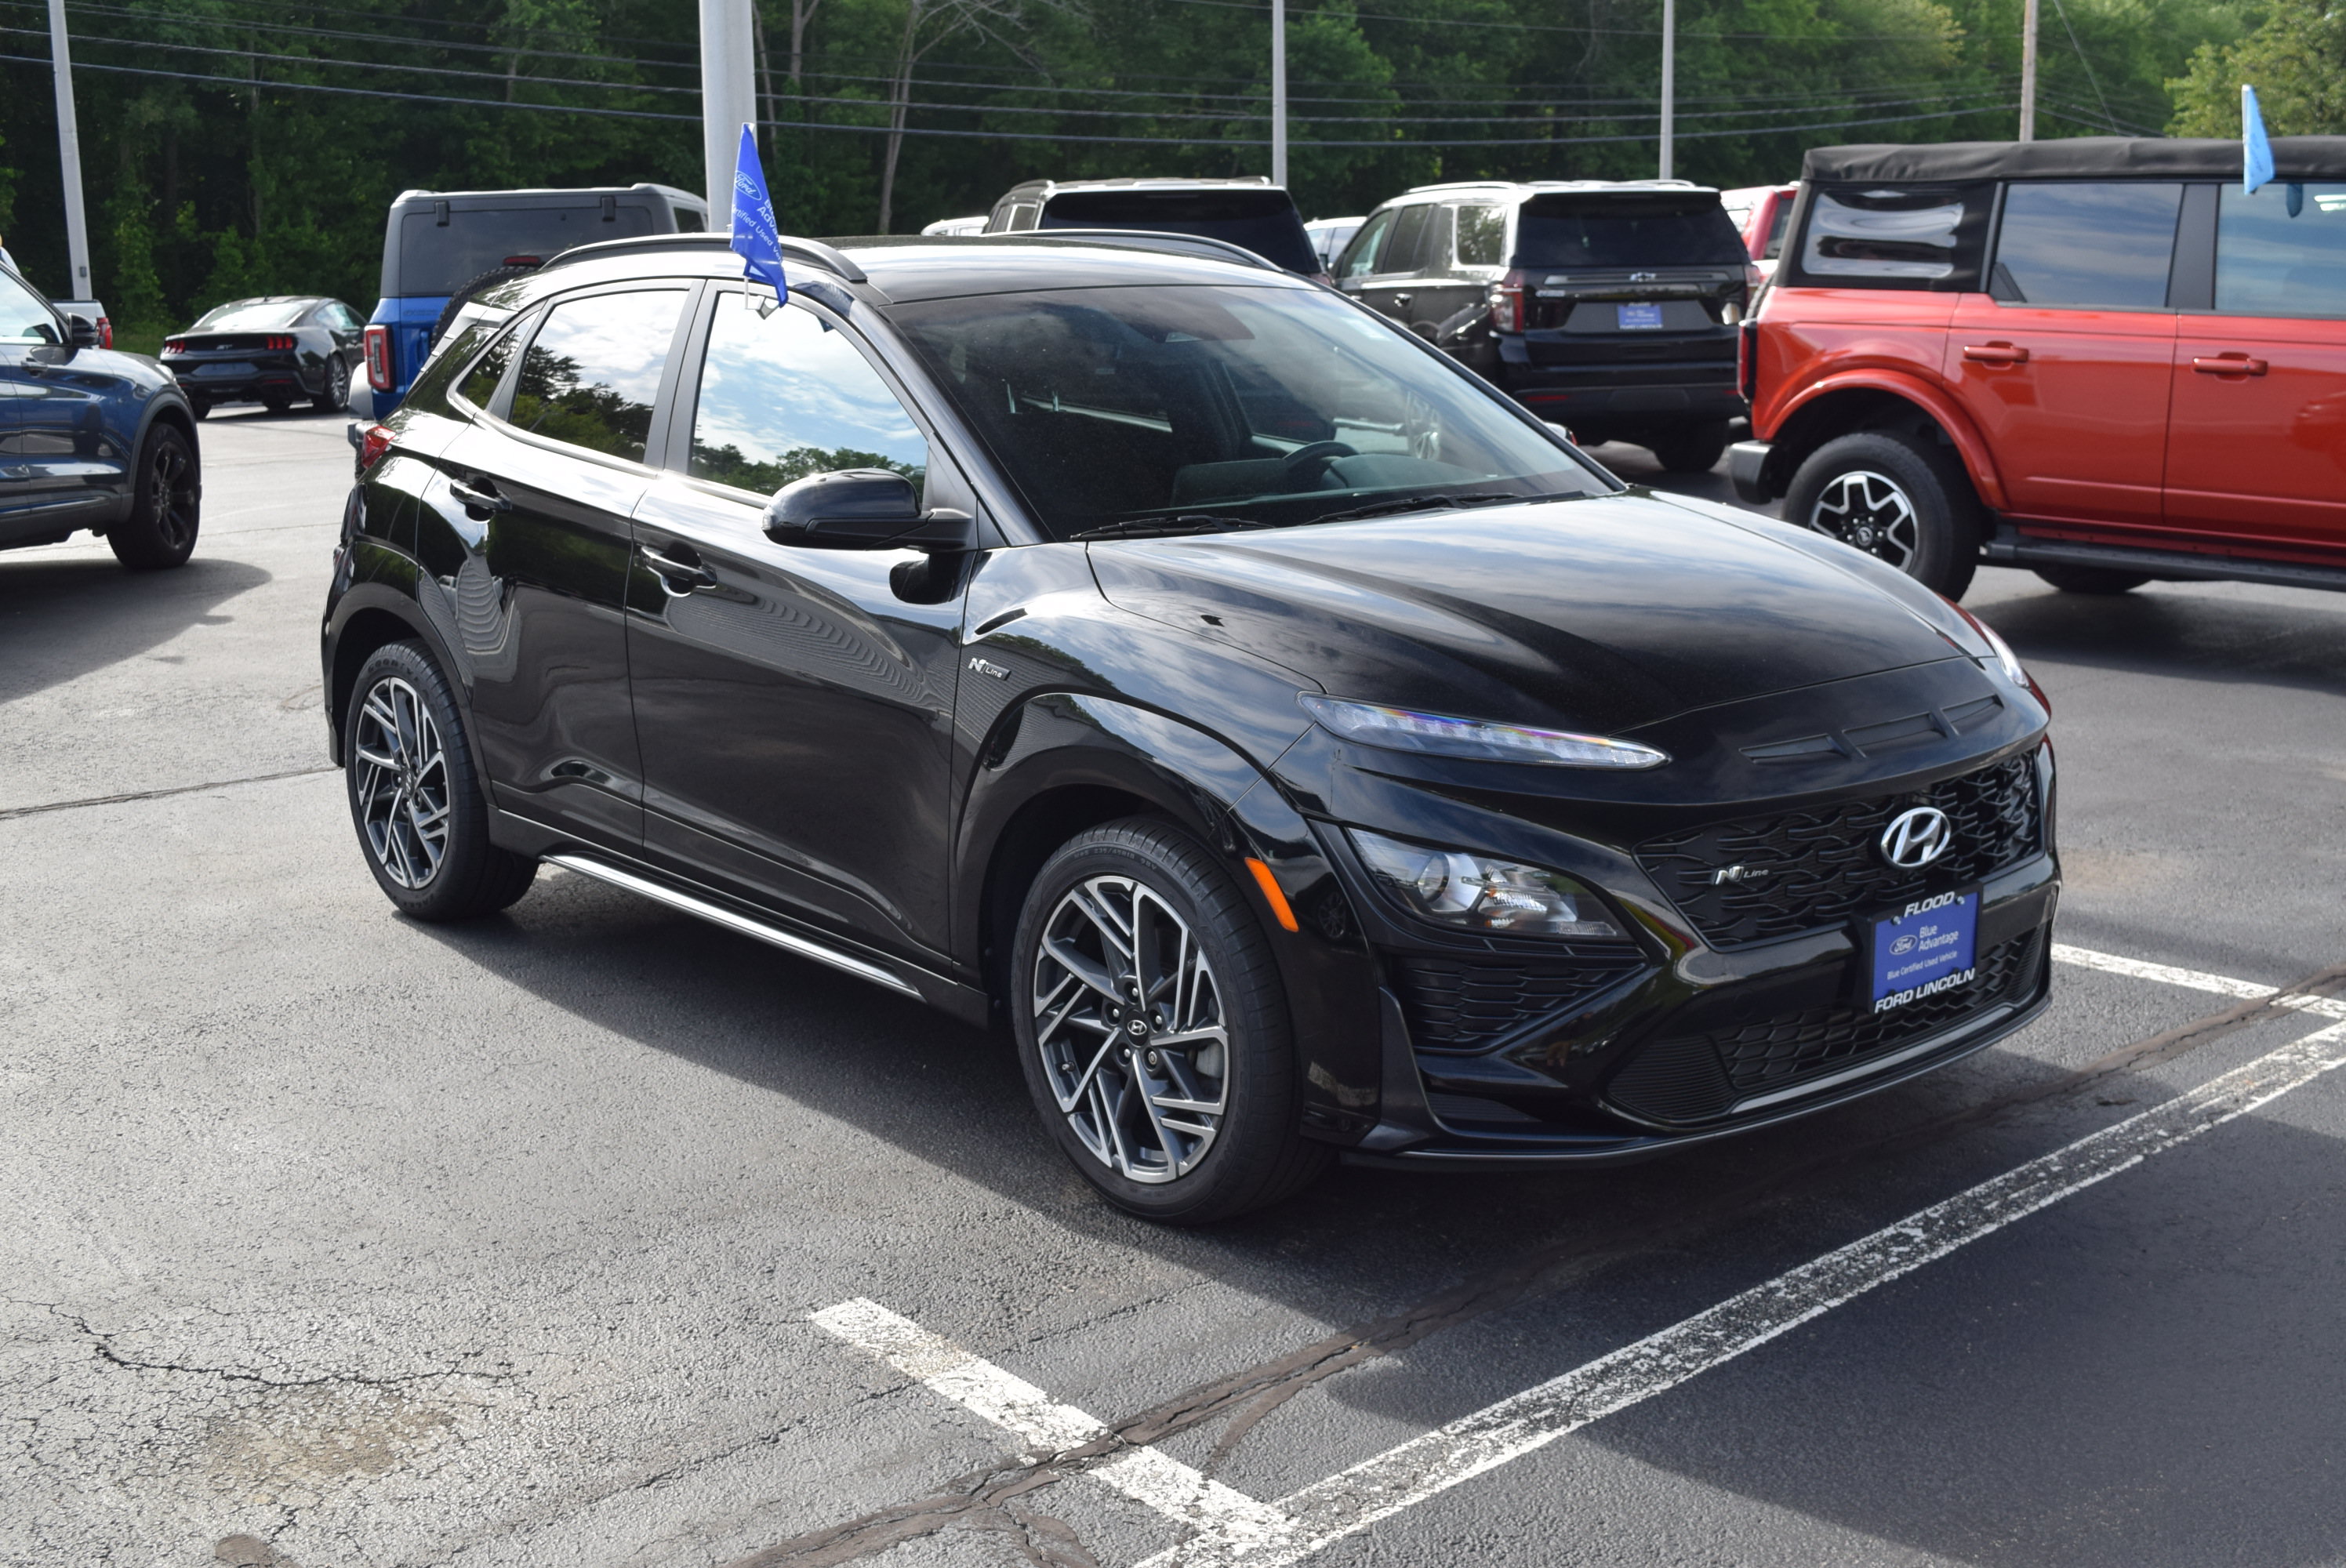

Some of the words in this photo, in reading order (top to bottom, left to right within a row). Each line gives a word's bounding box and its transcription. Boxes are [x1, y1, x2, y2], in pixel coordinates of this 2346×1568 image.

[735, 173, 757, 194] Ford
[755, 225, 774, 246] Used
[968, 657, 987, 673] N
[985, 666, 1003, 678] Line
[1715, 866, 1743, 885] N
[1743, 869, 1769, 878] Line
[1904, 891, 1955, 918] FLOOD
[1918, 931, 1959, 952] Advantage
[1919, 925, 1937, 938] Blue
[1893, 938, 1914, 953] Ford
[1887, 970, 1900, 980] Blue
[1900, 961, 1924, 976] Certified
[1924, 956, 1939, 967] Used
[1939, 949, 1958, 963] Vehicle
[1874, 989, 1914, 1014] FORD
[1916, 967, 1976, 999] LINCOLN
